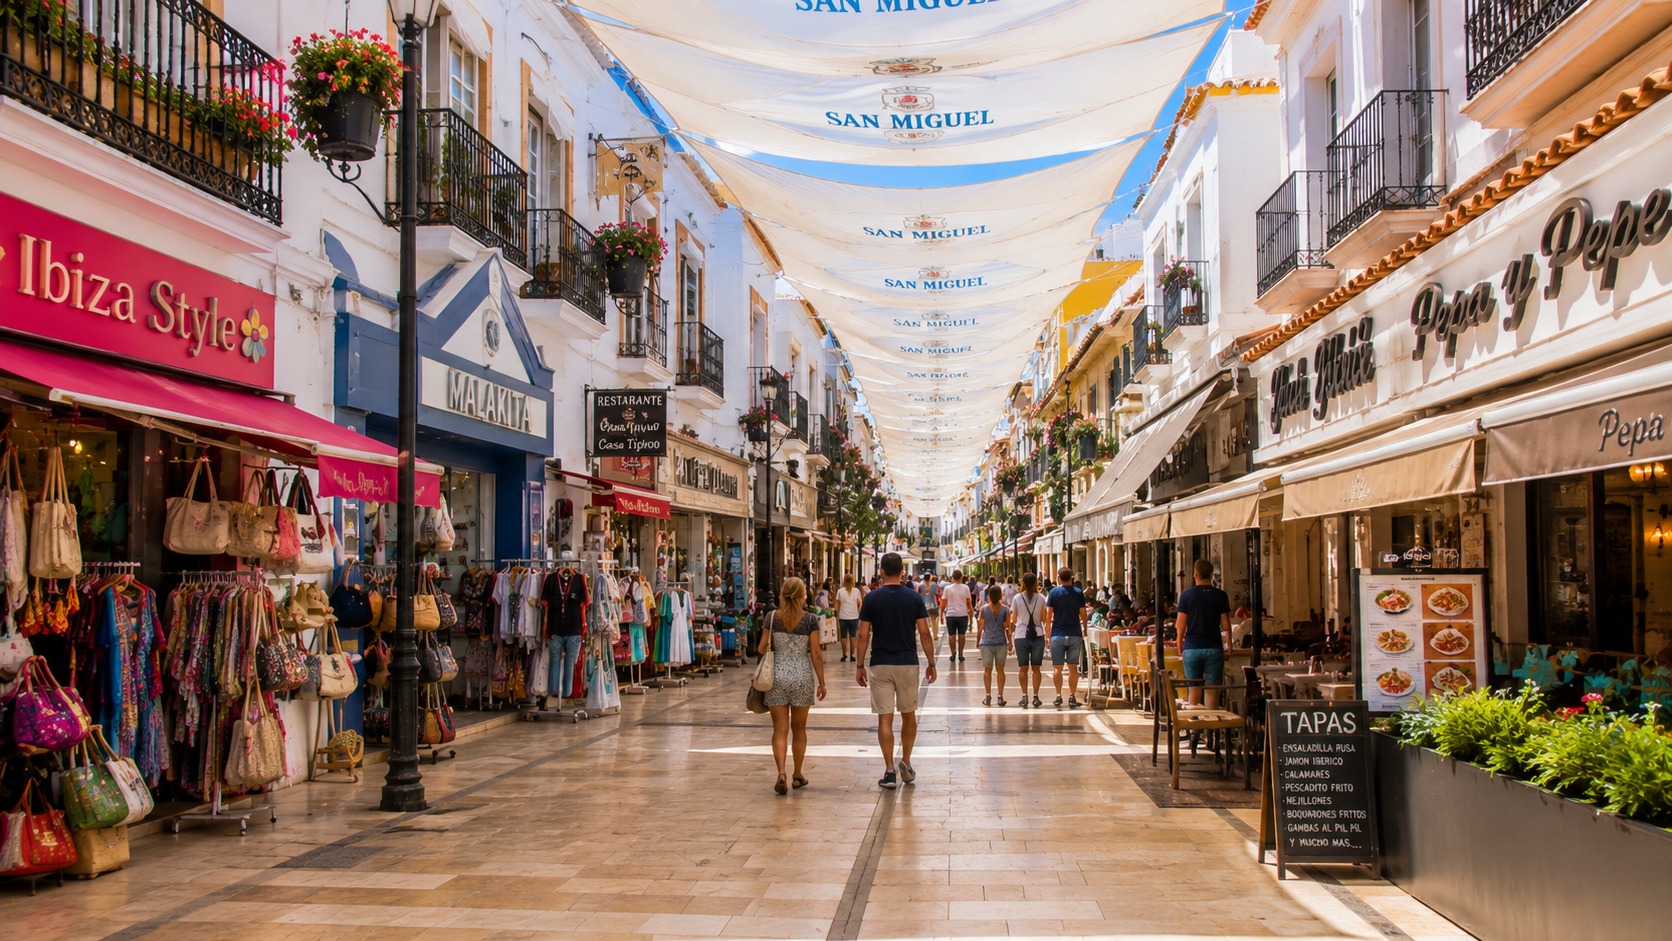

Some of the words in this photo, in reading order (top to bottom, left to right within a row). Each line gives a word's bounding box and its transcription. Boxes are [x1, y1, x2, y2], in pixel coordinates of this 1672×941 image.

[825, 111, 880, 129] SAN
[890, 110, 995, 130] MIGUEL
[862, 226, 903, 239] SAN
[912, 224, 991, 240] MIGUEL
[1410, 281, 1498, 361] Pepa
[1500, 254, 1538, 332] y
[1541, 188, 1672, 301] Pepe
[884, 278, 917, 290] SAN
[923, 276, 988, 290] MIGUEL
[17, 233, 137, 324] Ibiza
[147, 280, 236, 357] Style
[893, 318, 921, 328] SAN
[448, 367, 532, 433] MALAKITA
[597, 395, 662, 406] RESTARANTE
[1598, 407, 1664, 457] Pepa
[1280, 711, 1356, 734] TAPAS
[1285, 783, 1328, 792] PESCADITO
[1330, 783, 1354, 792] FRITO
[1322, 823, 1332, 833] AL
[1334, 823, 1348, 833] PIL
[1289, 838, 1295, 848] Y
